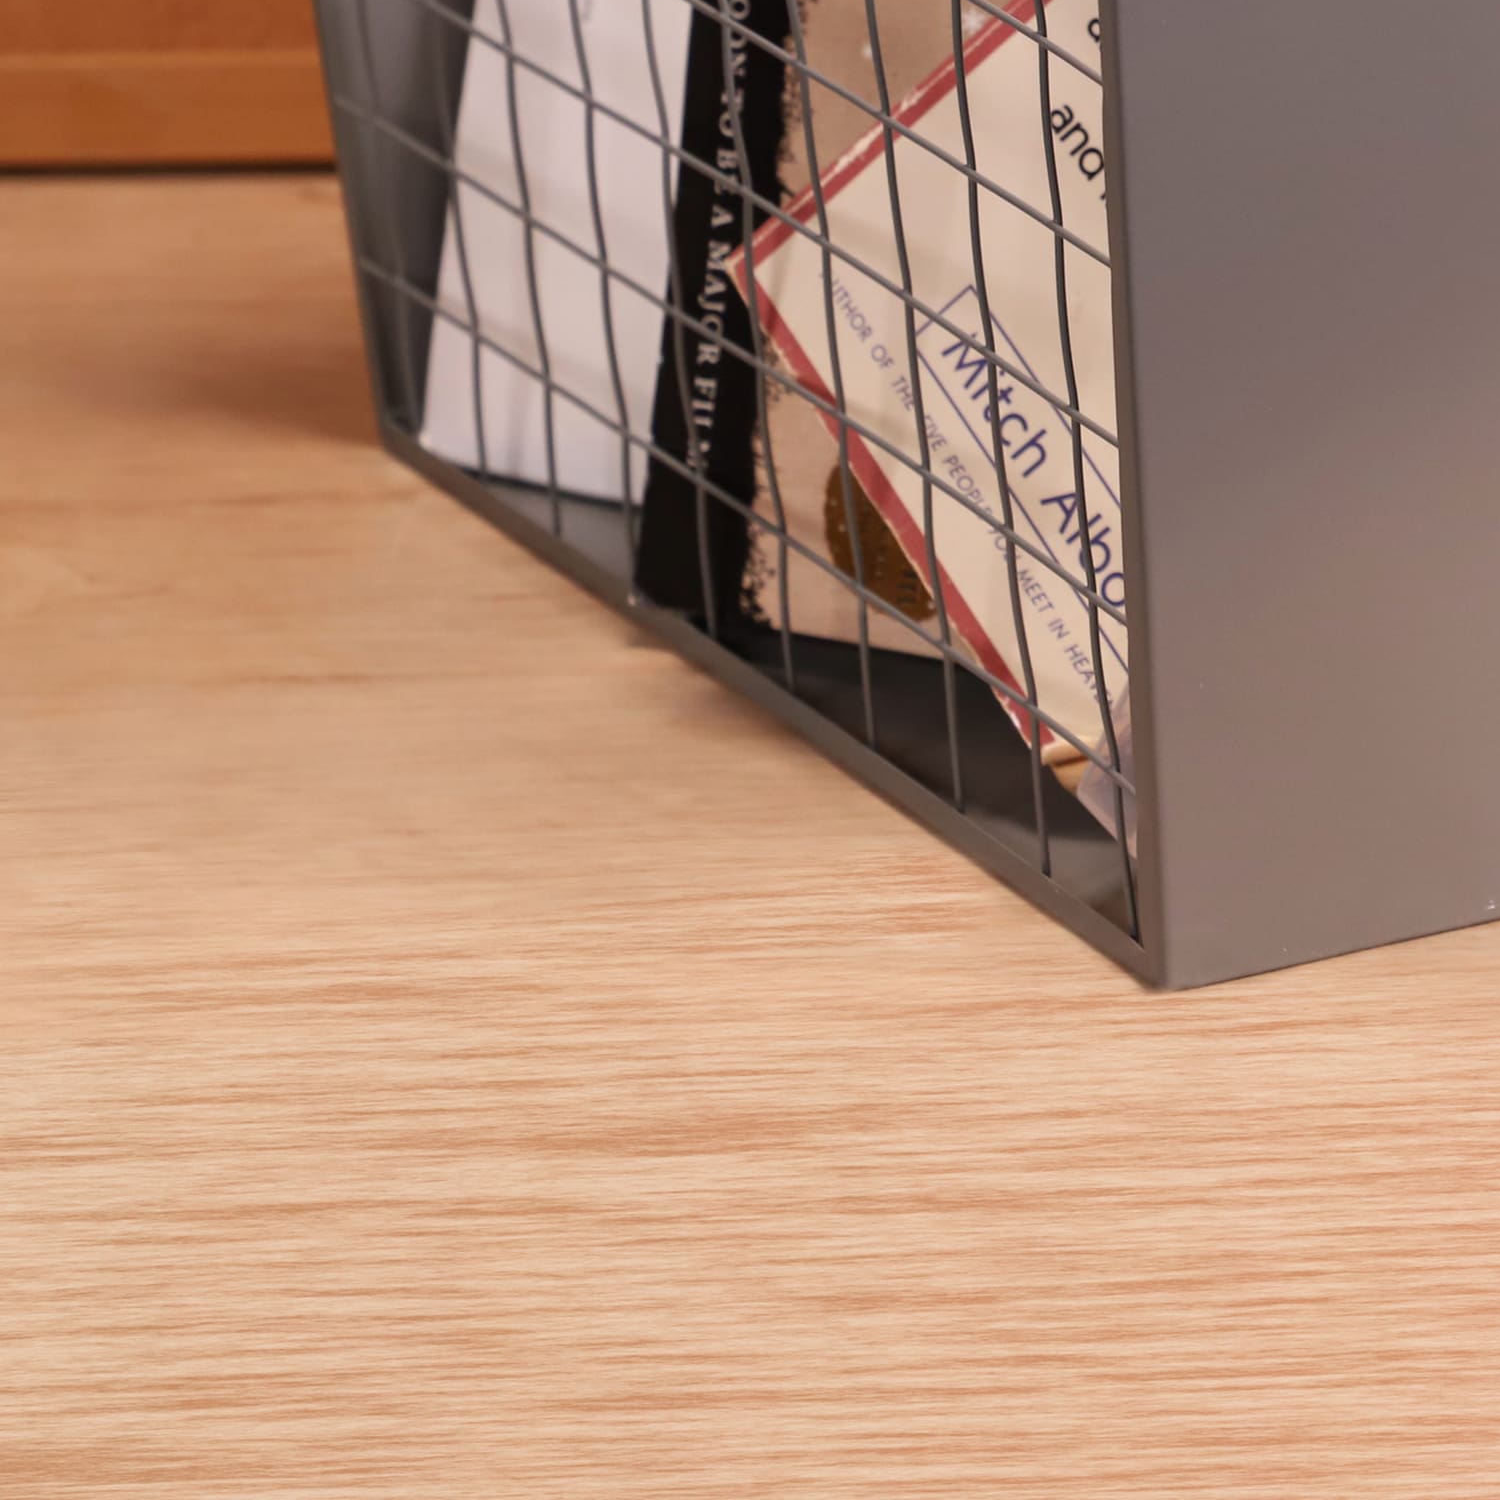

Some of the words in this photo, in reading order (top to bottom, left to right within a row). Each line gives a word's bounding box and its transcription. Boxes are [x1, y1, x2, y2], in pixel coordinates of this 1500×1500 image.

[710, 203, 735, 229] A
[697, 240, 732, 366] MAJOR
[941, 330, 1048, 478] Mitch
[818, 269, 873, 342] UTHOR
[870, 343, 895, 370] OF
[890, 373, 916, 412] THE
[1018, 569, 1056, 614] MEET
[1048, 618, 1071, 641] IN
[1064, 644, 1113, 704] HEA
